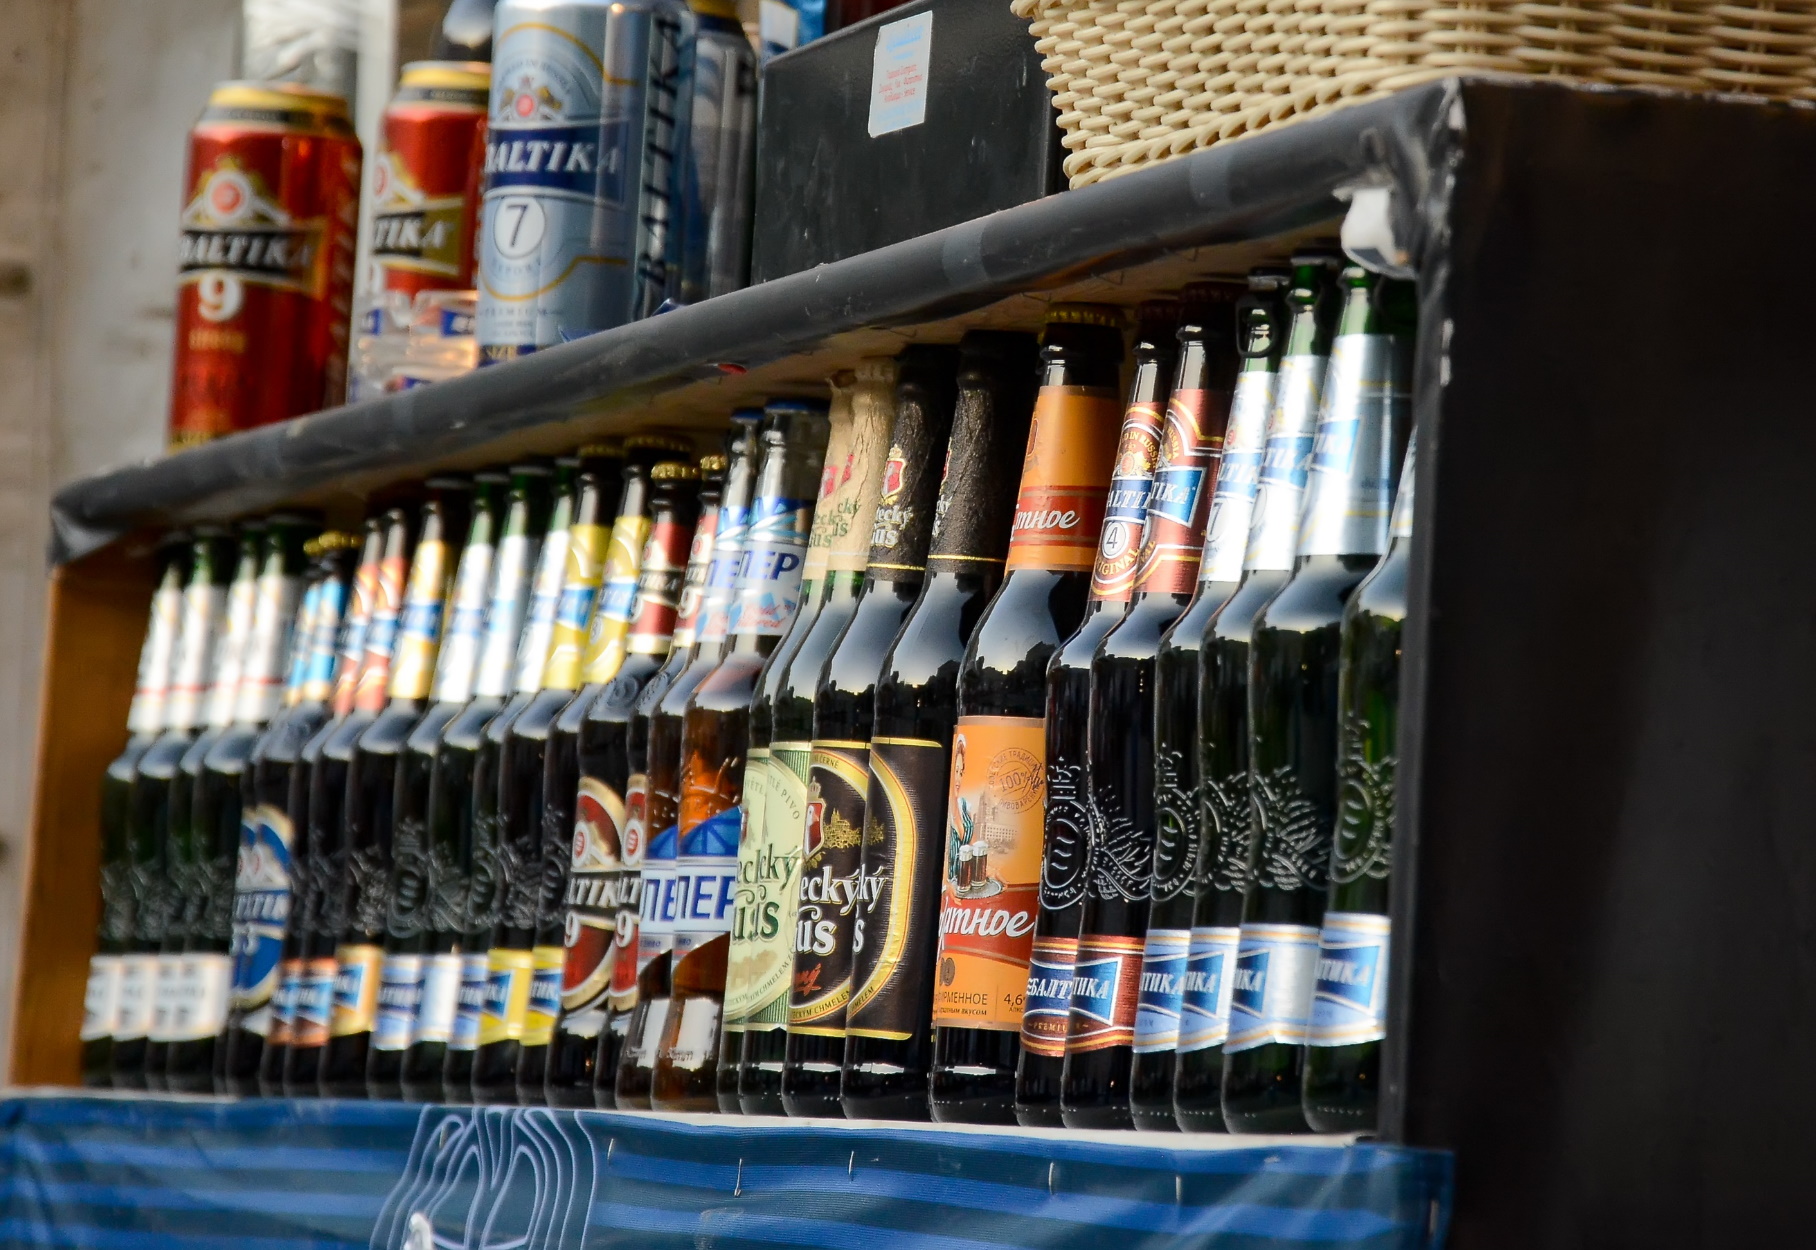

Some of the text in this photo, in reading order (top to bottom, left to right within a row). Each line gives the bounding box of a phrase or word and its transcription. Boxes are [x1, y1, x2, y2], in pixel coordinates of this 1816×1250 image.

[505, 204, 529, 248] 7
[199, 271, 242, 322] 9
[1107, 527, 1117, 549] 4
[781, 788, 800, 820] PIVO
[564, 910, 580, 948] 9
[615, 910, 634, 948] 9
